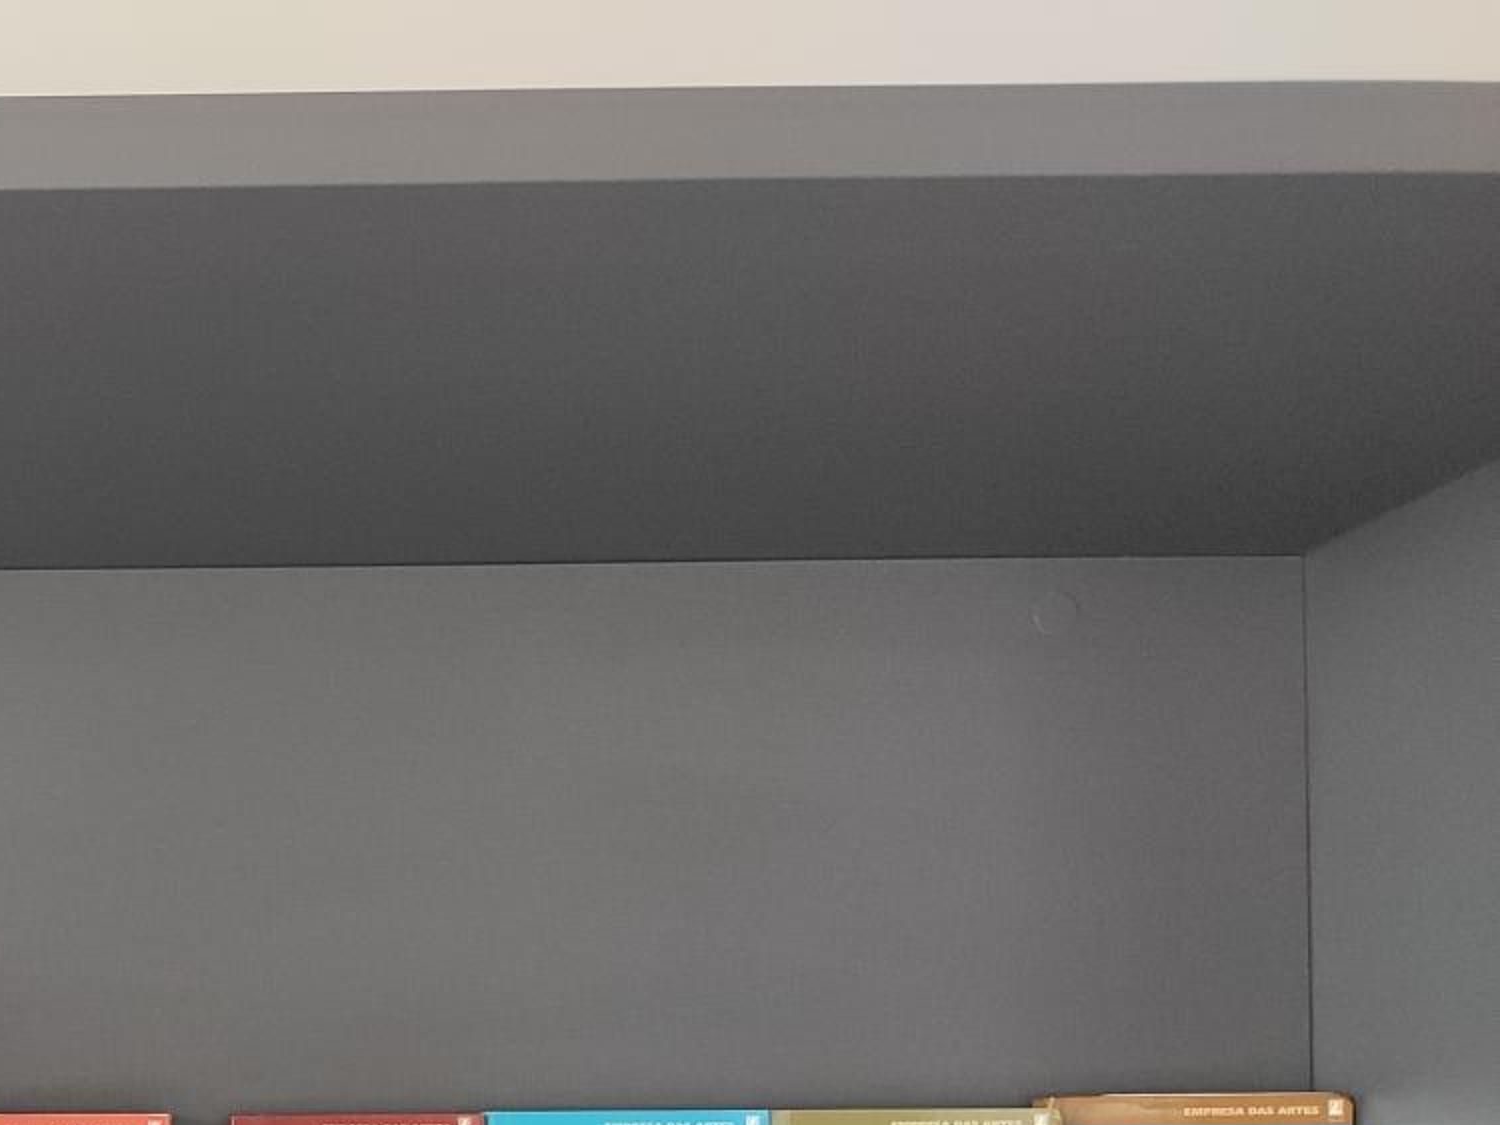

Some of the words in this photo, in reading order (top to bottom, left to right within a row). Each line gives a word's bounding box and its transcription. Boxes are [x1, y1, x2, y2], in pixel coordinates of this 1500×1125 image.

[1183, 1107, 1245, 1117] EMPRESA
[1248, 1106, 1274, 1116] DAS
[1278, 1105, 1320, 1116] ARTES
